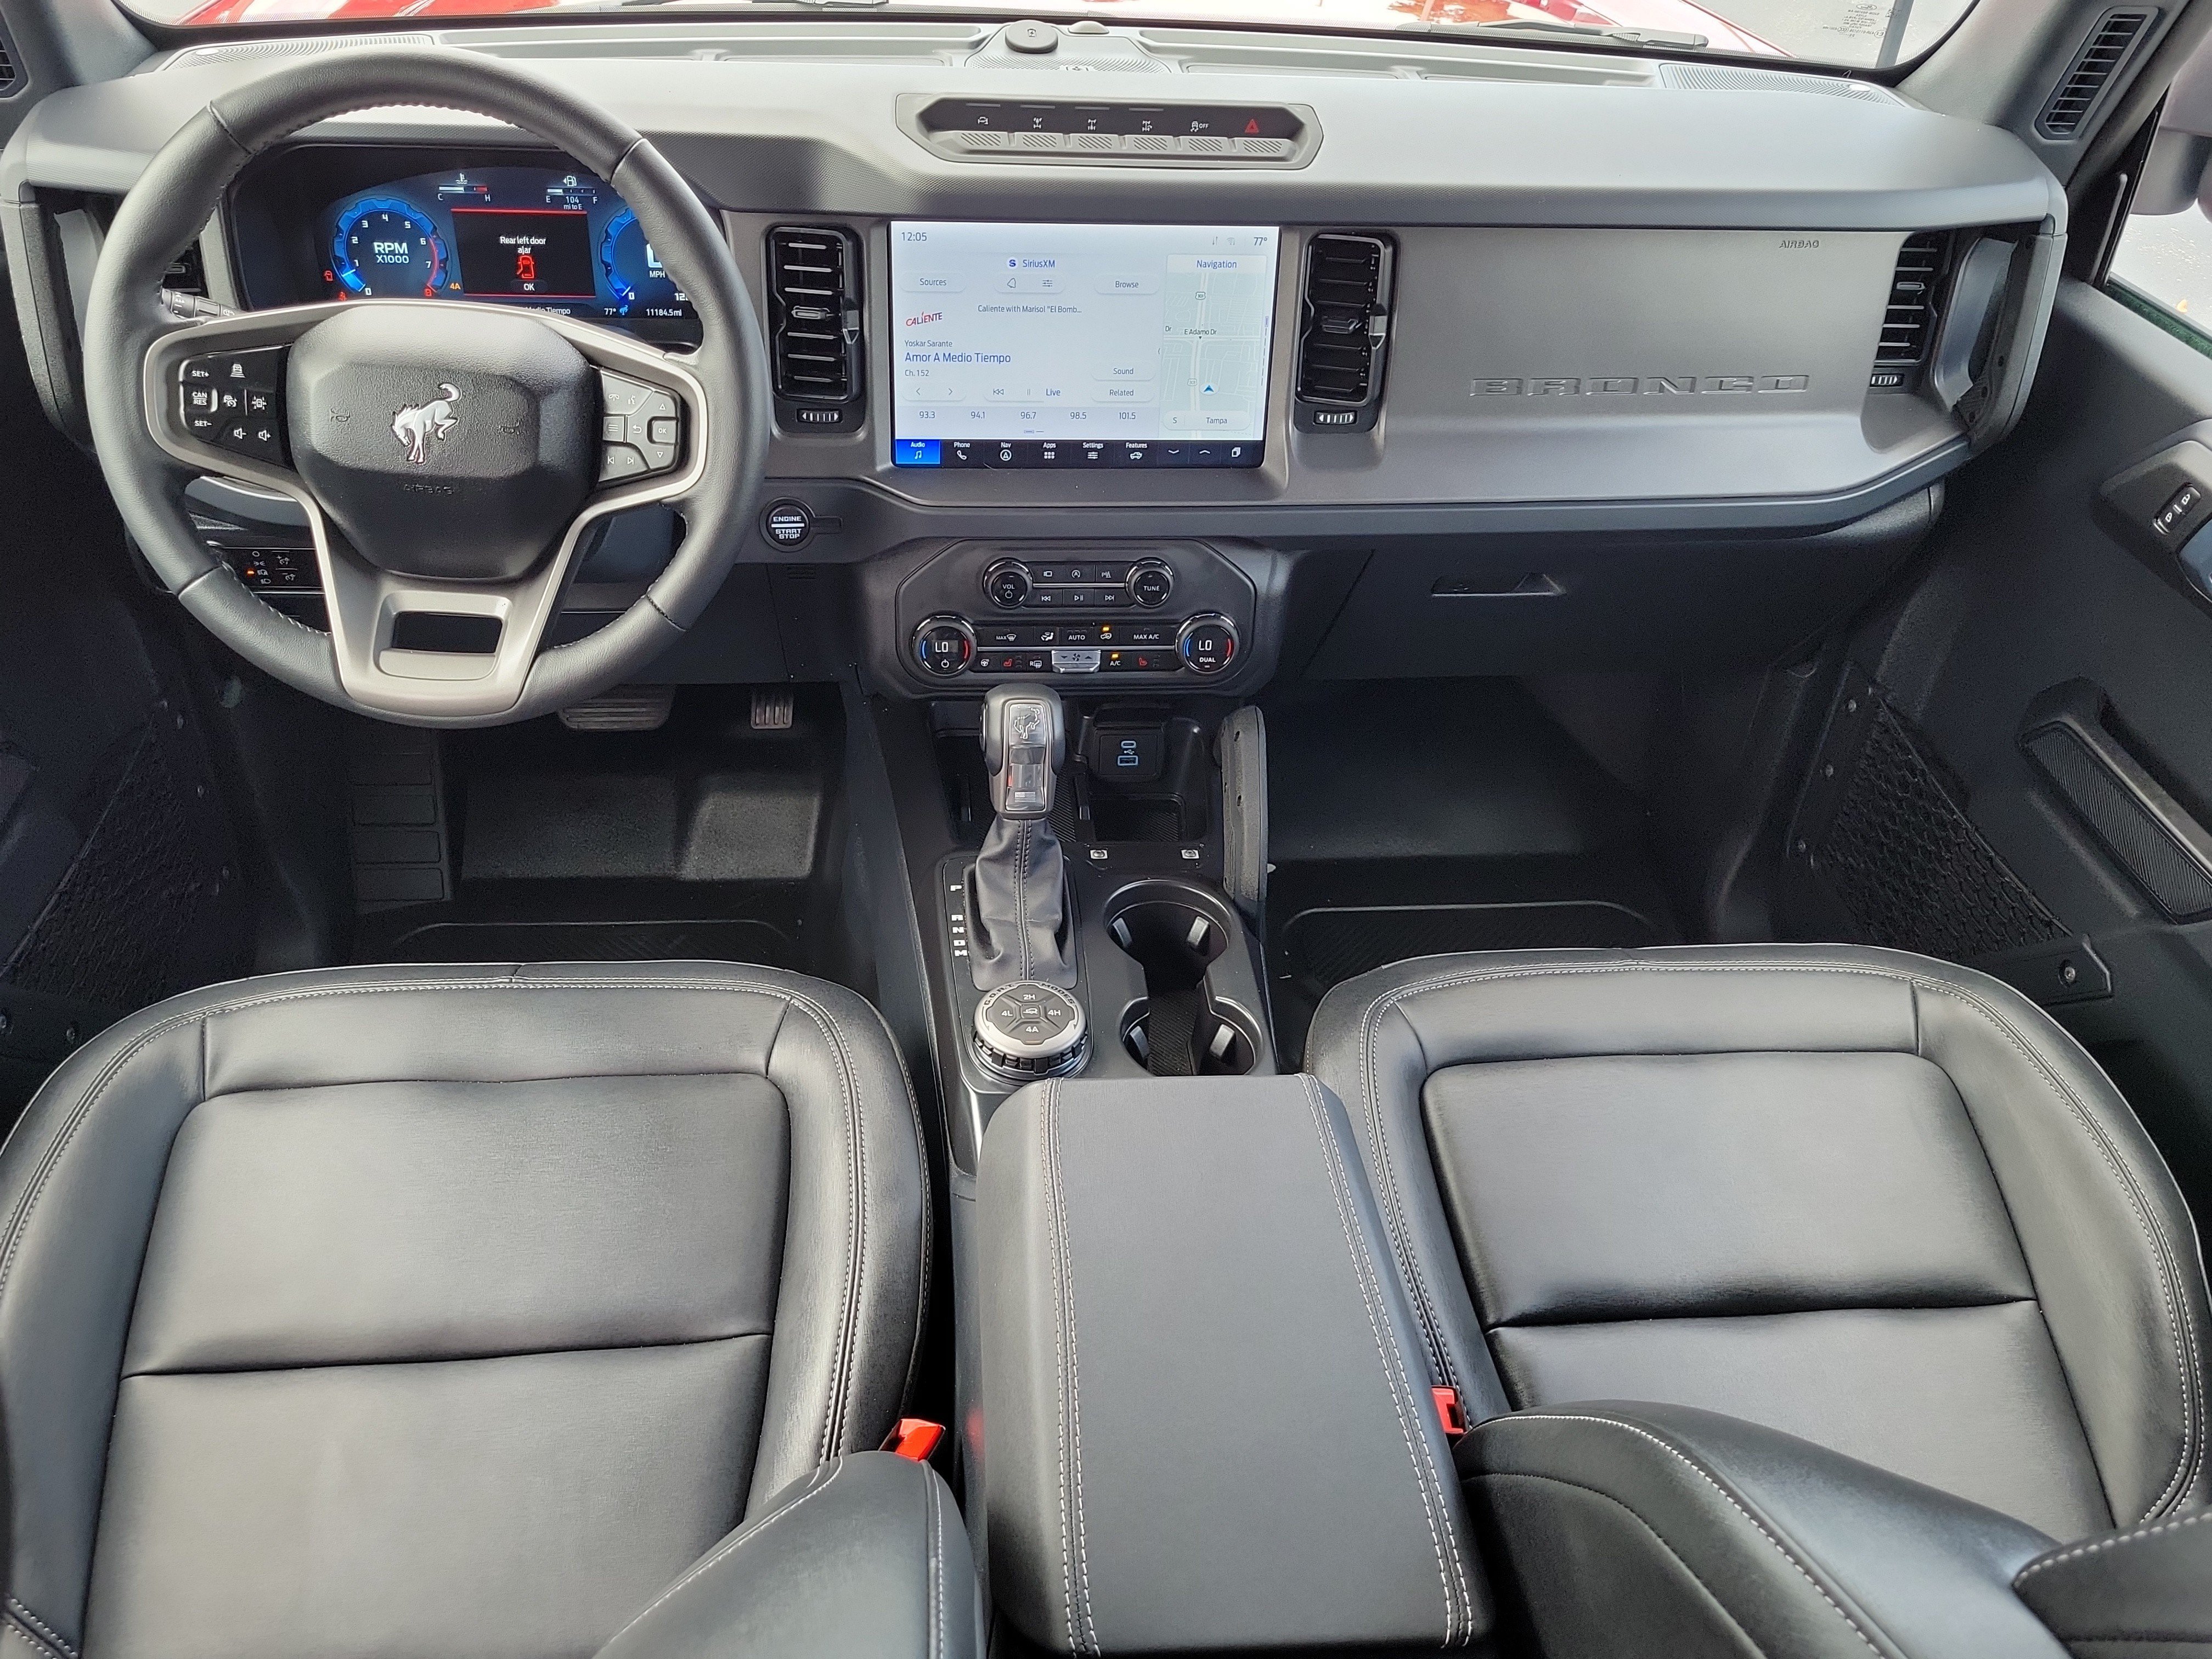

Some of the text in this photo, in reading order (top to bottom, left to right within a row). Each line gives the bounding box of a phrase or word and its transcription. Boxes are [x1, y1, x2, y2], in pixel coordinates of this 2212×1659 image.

[500, 236, 546, 245] Rear left door
[901, 232, 927, 241] 12:05
[1253, 236, 1267, 246] 77°
[374, 242, 408, 254] RPM
[1779, 240, 1819, 249] AIRBAG
[517, 246, 531, 255] ajar
[376, 255, 409, 263] X1000
[1022, 259, 1056, 268] SiriusXM
[1197, 260, 1237, 269] Navigation
[674, 293, 689, 301] 12
[978, 305, 1005, 313] Caliente
[1006, 305, 1020, 313] with
[1022, 305, 1046, 313] Marisol
[1047, 305, 1057, 313] "El
[906, 311, 943, 326] CALIENTE
[905, 352, 1011, 364] Amor A Medio Tiempo
[1469, 375, 1810, 396] BRONCO
[1206, 417, 1227, 425] Tampa
[935, 642, 949, 652] LO
[1199, 640, 1212, 651] LO
[1041, 983, 1075, 1005] MODES
